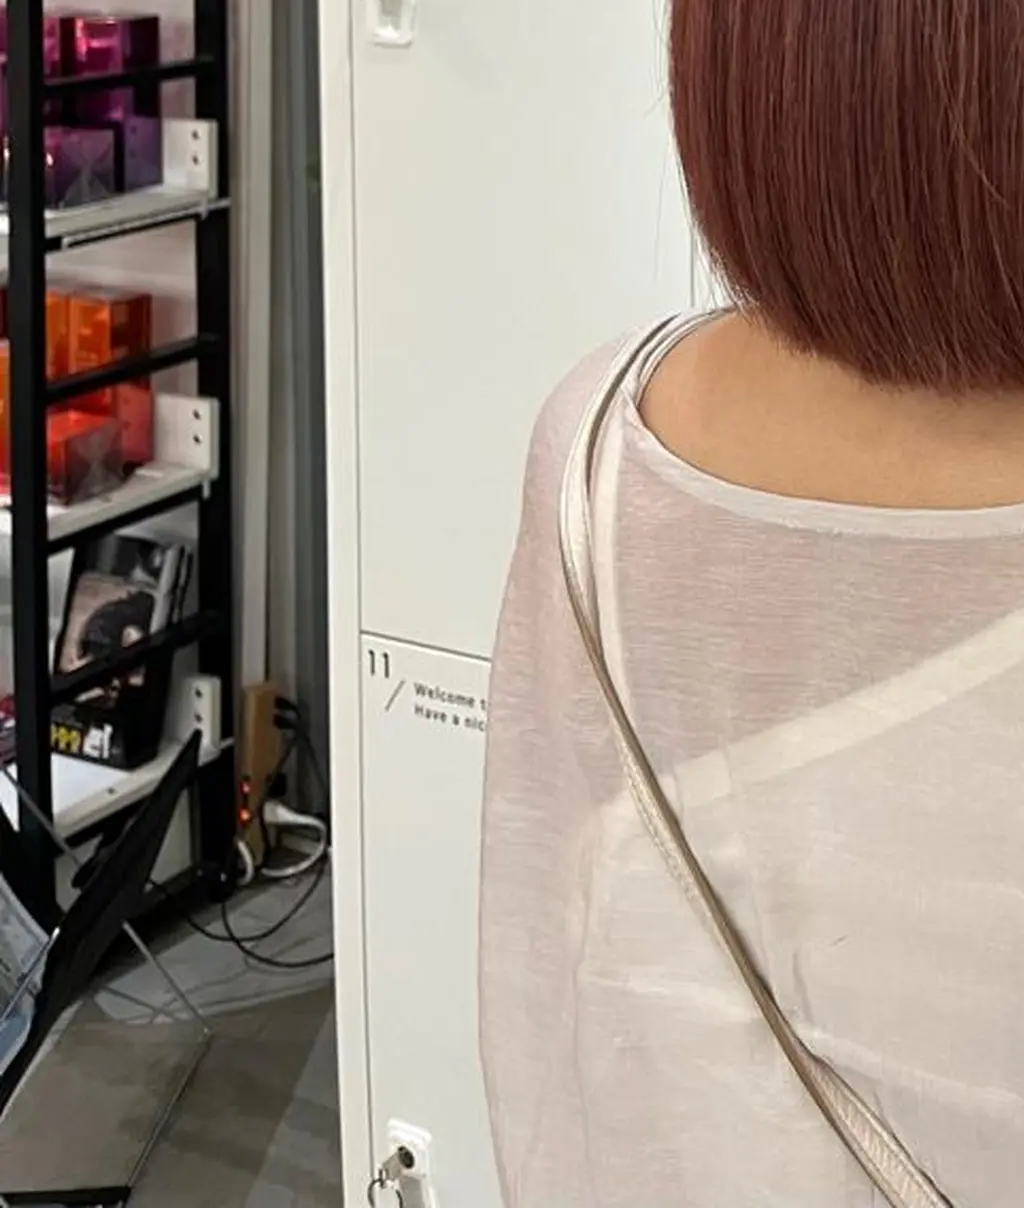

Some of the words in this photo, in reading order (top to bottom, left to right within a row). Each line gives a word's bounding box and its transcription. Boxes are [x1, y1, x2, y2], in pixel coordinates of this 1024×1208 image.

[368, 649, 390, 679] 11
[414, 682, 476, 709] Welcome
[414, 704, 447, 724] Have
[452, 714, 460, 726] a
